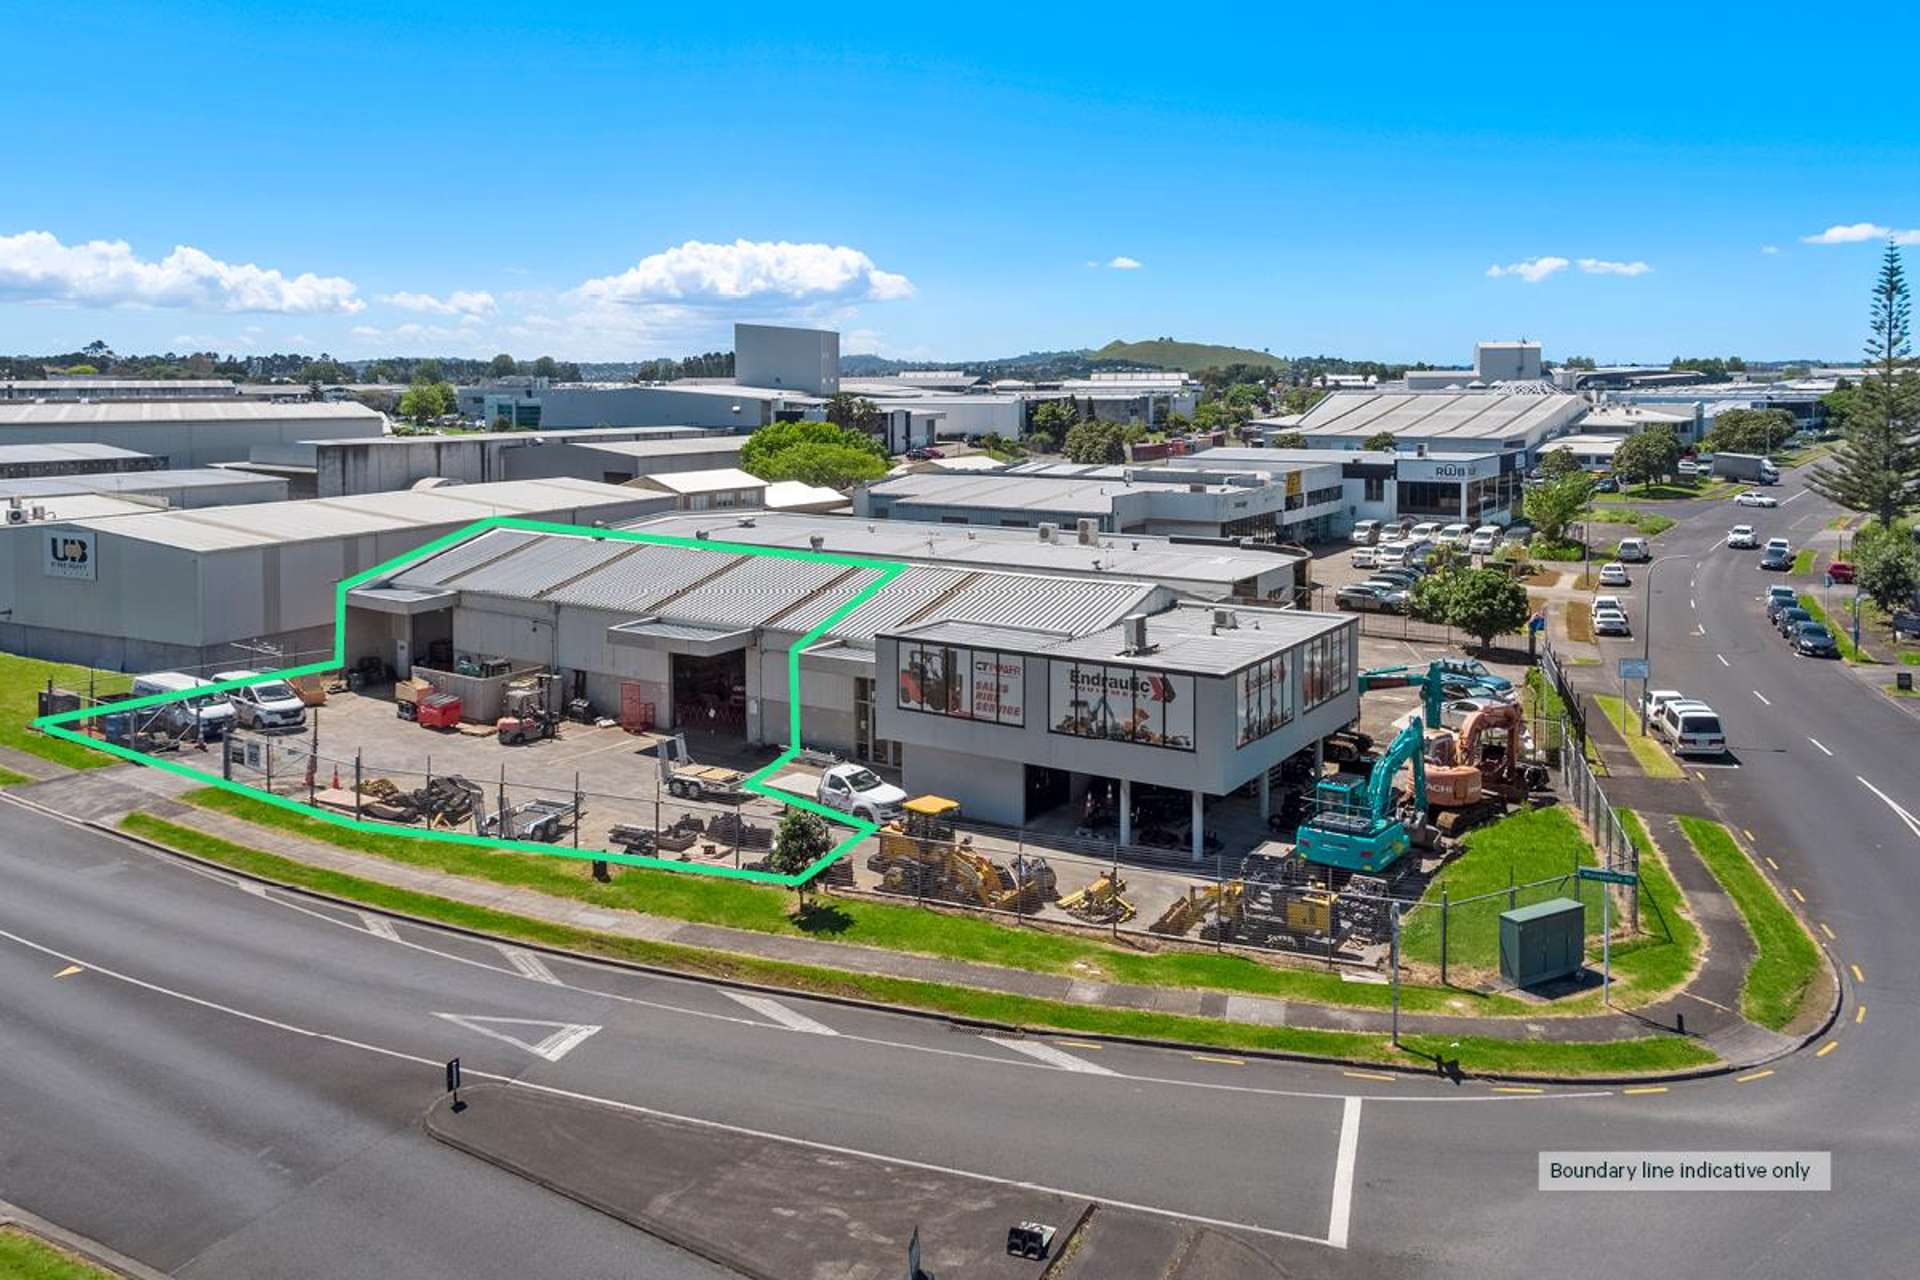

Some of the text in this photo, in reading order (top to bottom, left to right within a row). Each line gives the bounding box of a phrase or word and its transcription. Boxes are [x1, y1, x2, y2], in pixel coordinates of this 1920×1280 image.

[976, 680, 1009, 693] SALES
[1070, 669, 1151, 694] Endraulic
[976, 702, 1021, 716] SERVICE
